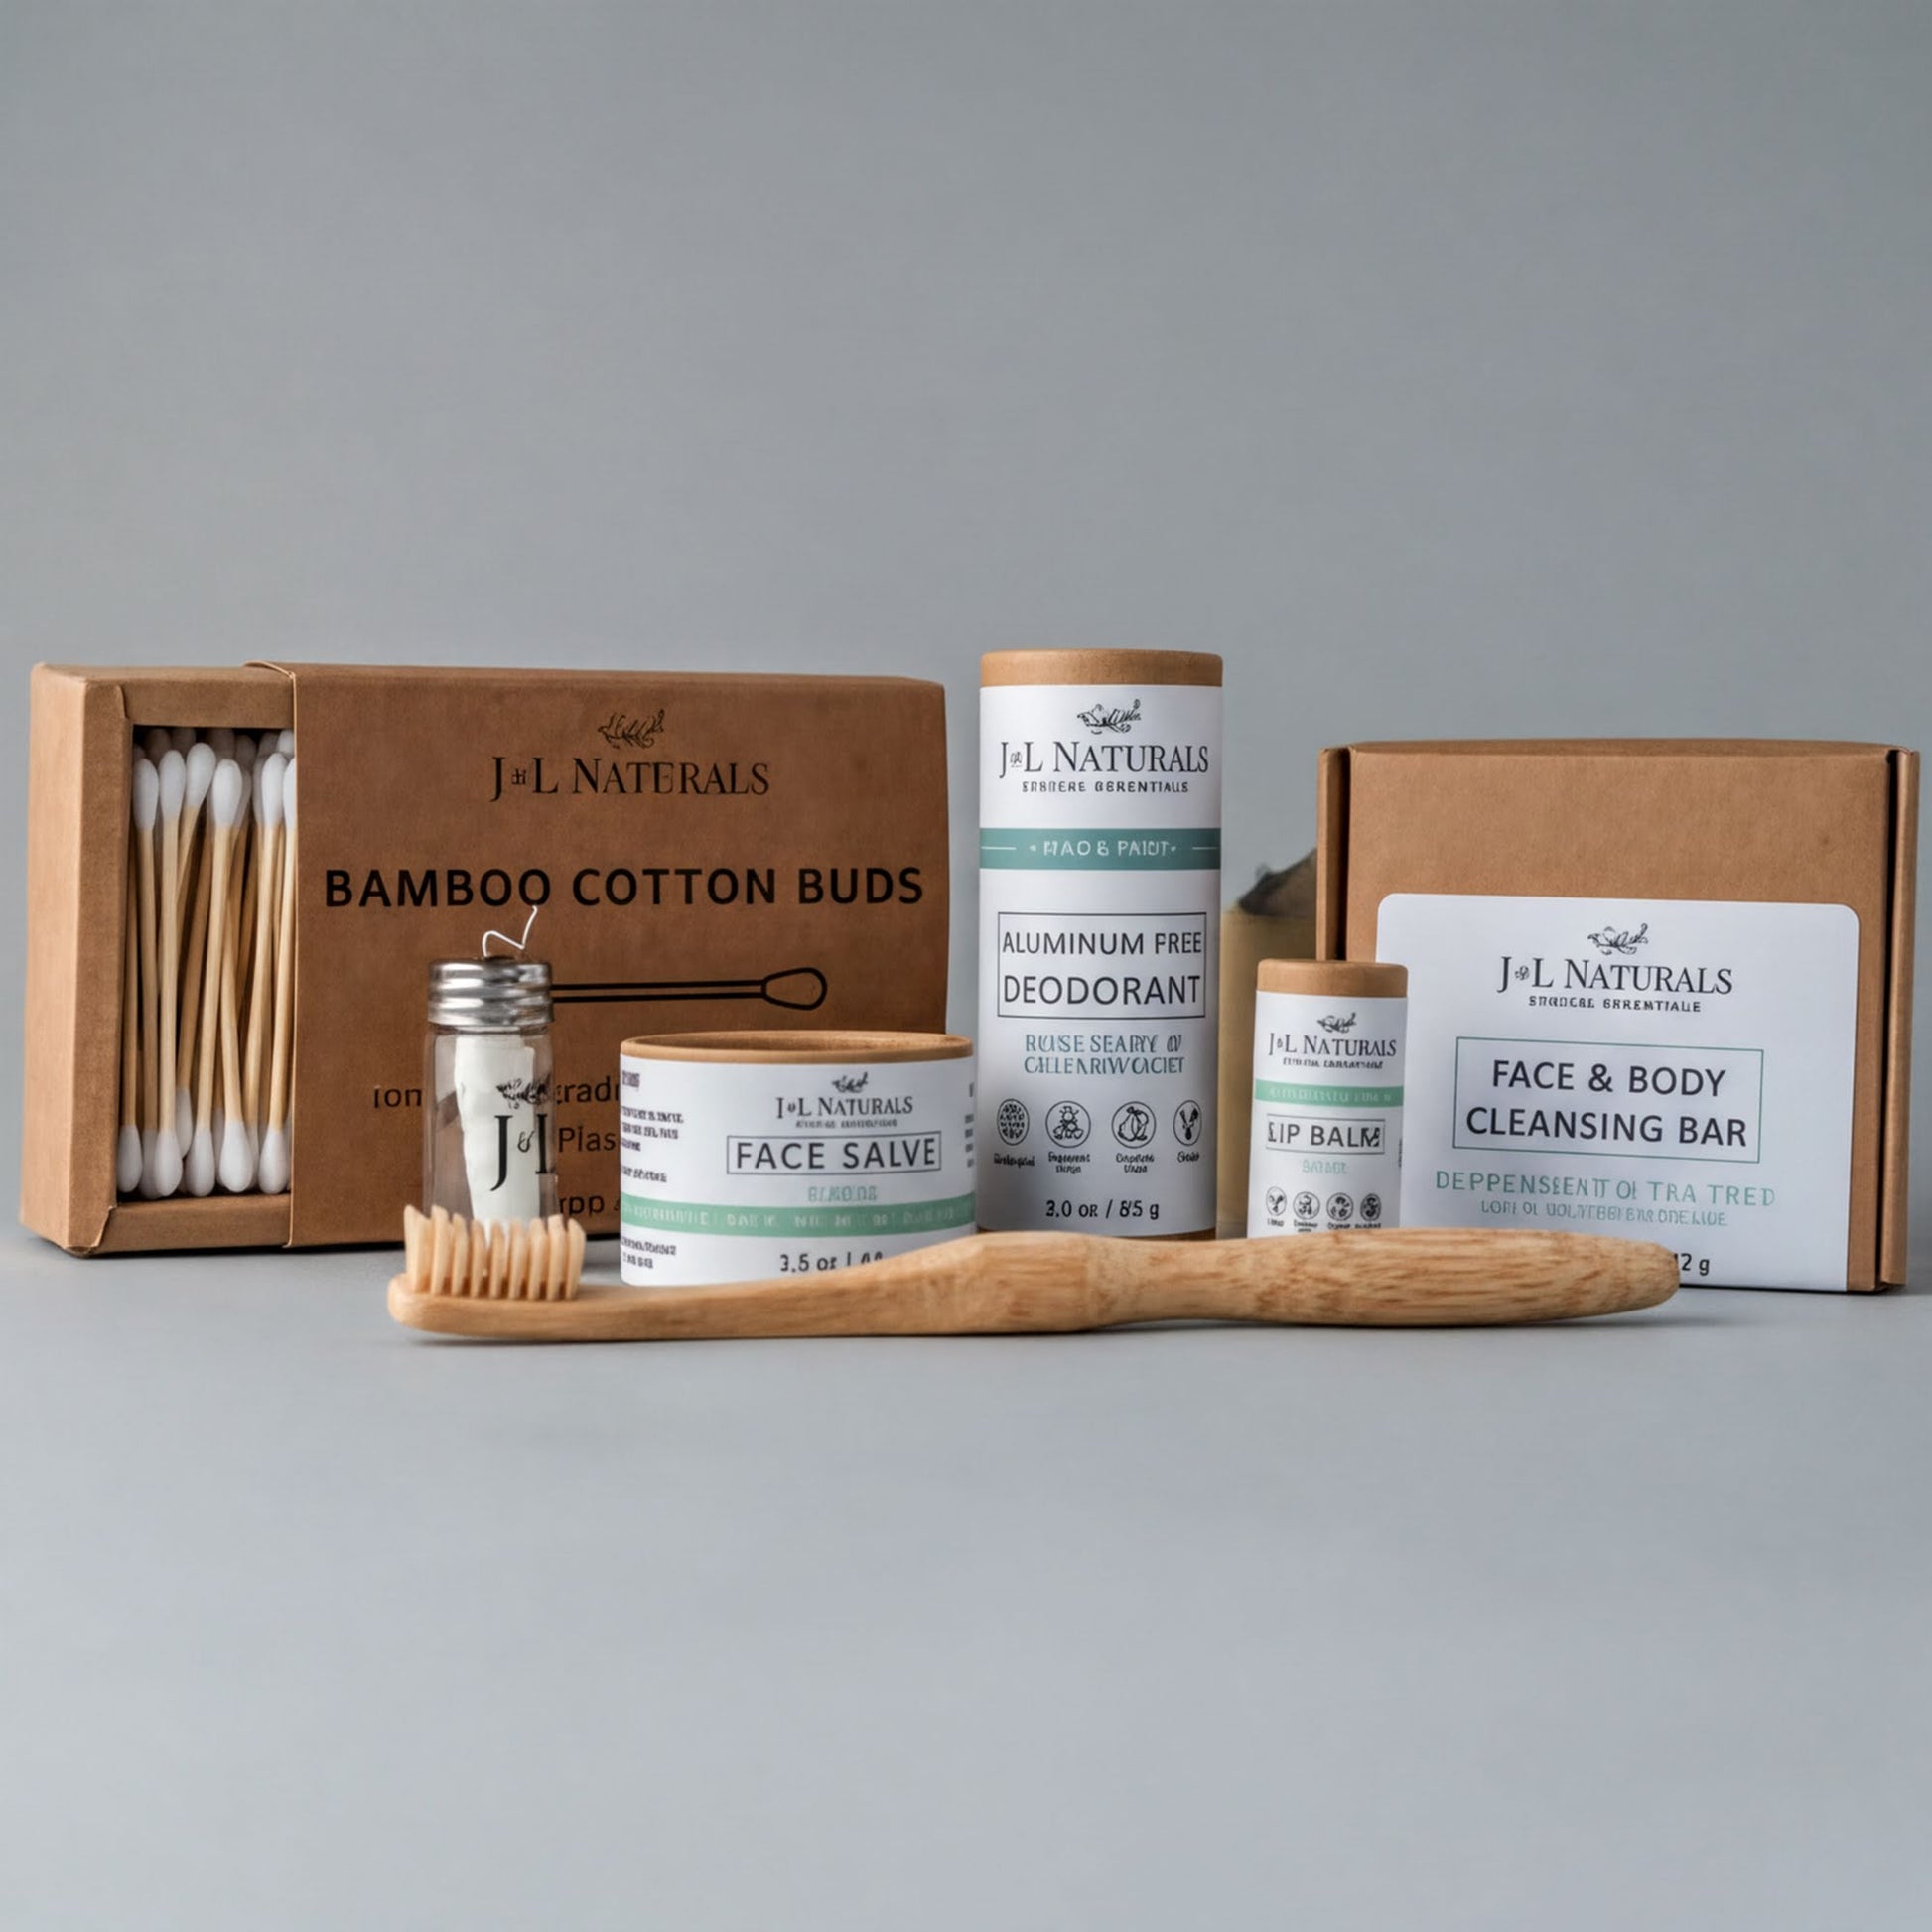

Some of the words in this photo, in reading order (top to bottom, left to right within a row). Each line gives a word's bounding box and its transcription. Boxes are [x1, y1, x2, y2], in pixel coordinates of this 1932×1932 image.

[1052, 741, 1209, 774] NATURALS
[325, 868, 552, 907] BAMBOO
[572, 867, 776, 906] COTTON
[798, 866, 925, 904] BUDS
[1002, 931, 1144, 955] ALUMINUM
[1155, 931, 1202, 954] FREE
[1004, 975, 1201, 1006] DEODORANT
[1564, 958, 1734, 995] NATURALS
[1303, 1035, 1397, 1057] NATURALS
[1493, 1059, 1576, 1091] FACE
[1588, 1063, 1614, 1093] &
[1628, 1065, 1727, 1097] BODY
[817, 1096, 914, 1117] NATURALS
[1466, 1106, 1664, 1144] CLEANSING
[1678, 1116, 1748, 1148] BAR
[736, 1142, 826, 1170] FACE
[841, 1138, 936, 1170] SALVE
[1150, 1202, 1160, 1220] g
[1699, 1258, 1711, 1277] g
